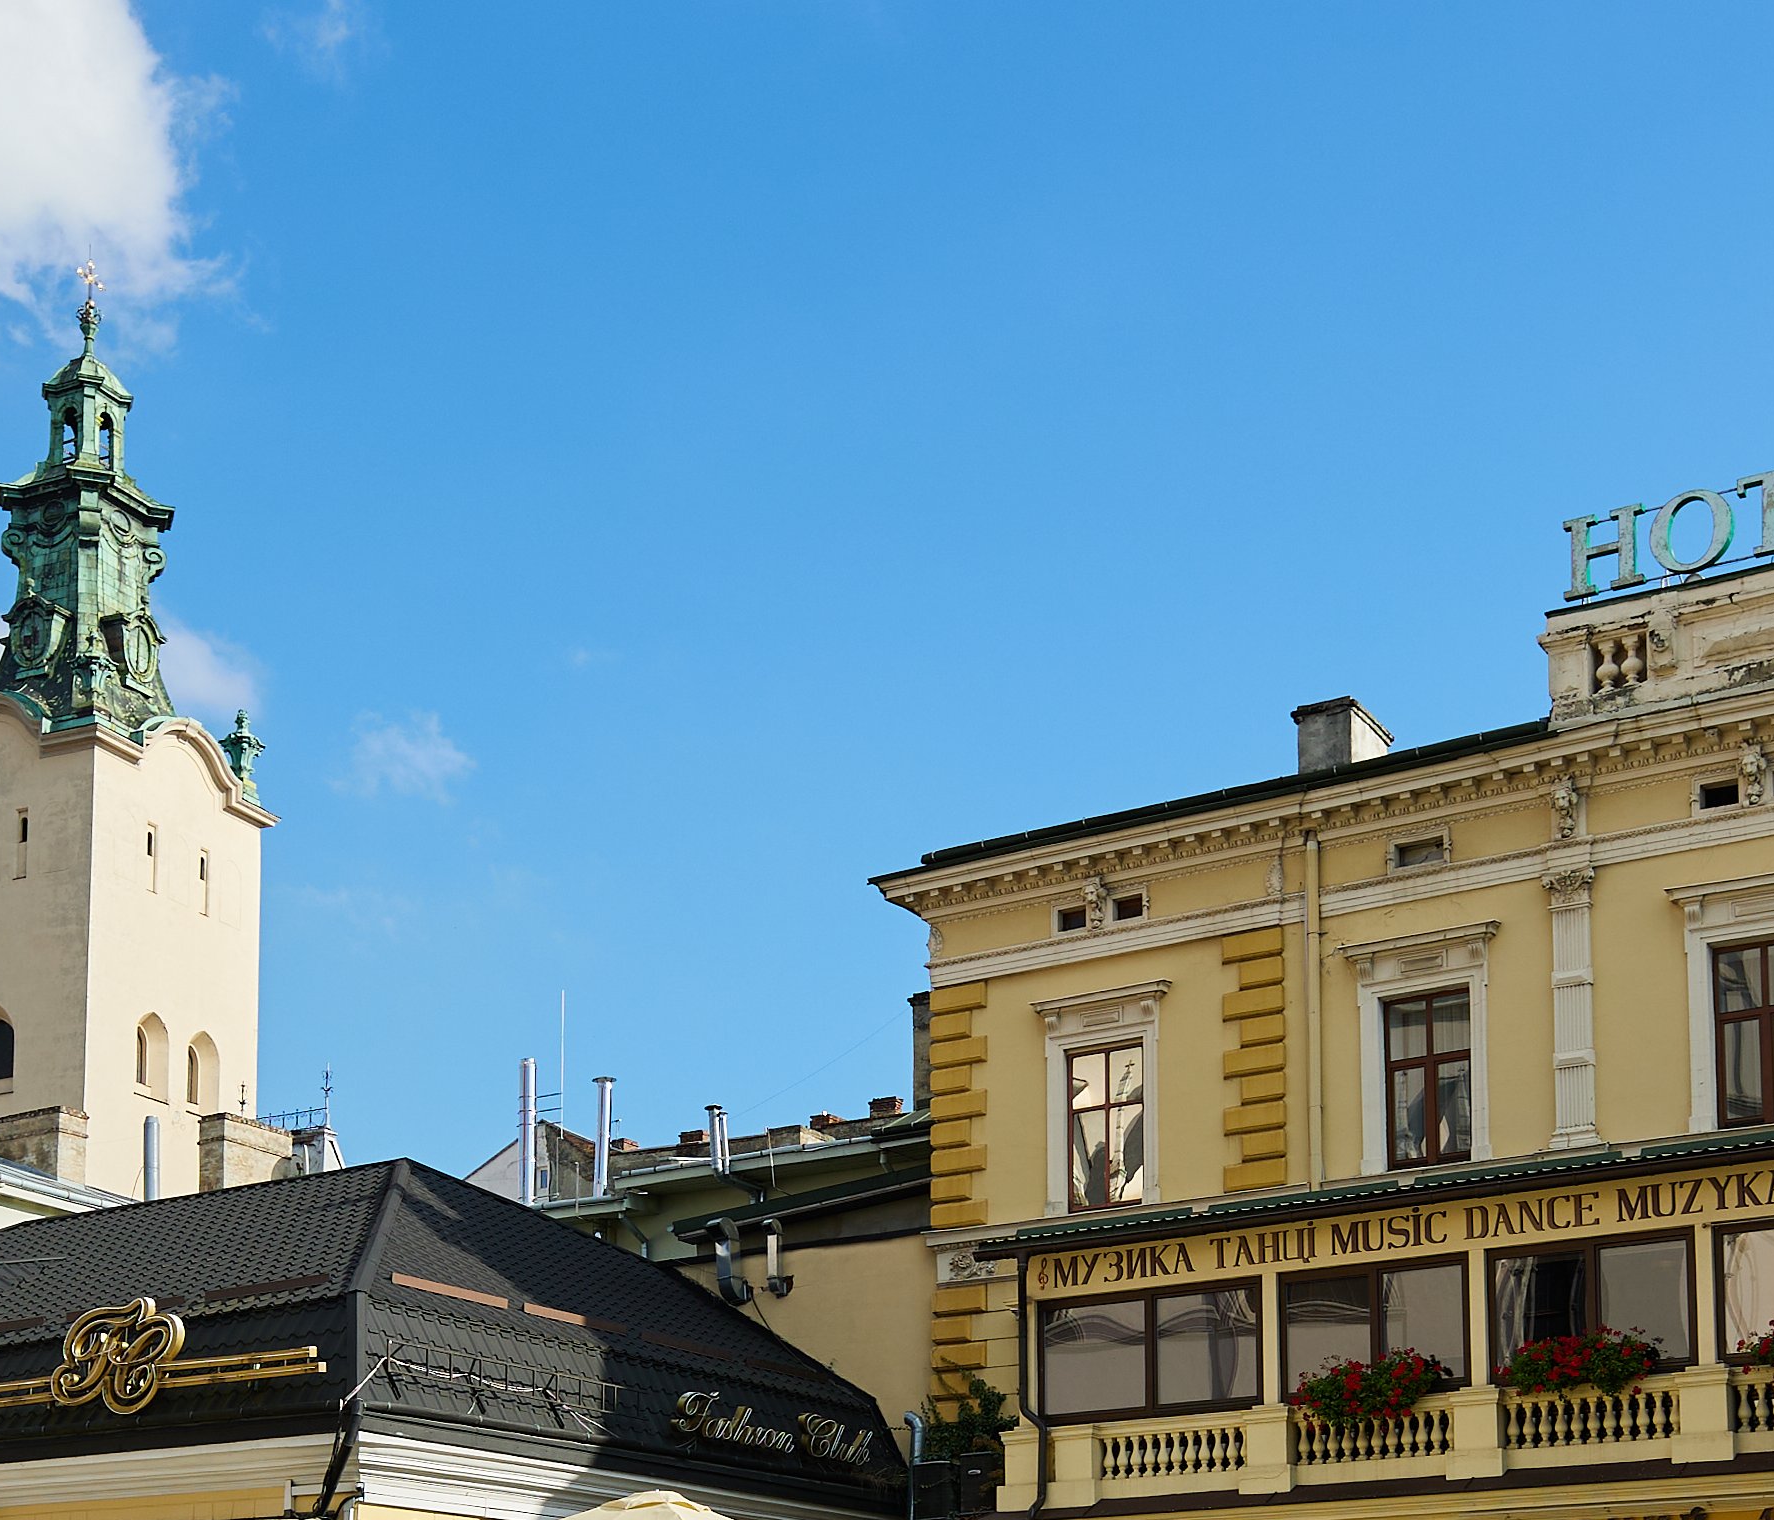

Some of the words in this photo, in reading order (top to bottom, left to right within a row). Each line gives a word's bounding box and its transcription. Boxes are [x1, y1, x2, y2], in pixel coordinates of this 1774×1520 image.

[1464, 1192, 1601, 1241] DANCE
[1052, 1242, 1196, 1289] МУЗИКА
[670, 1390, 796, 1454] Fashion
[798, 1410, 873, 1467] Club
